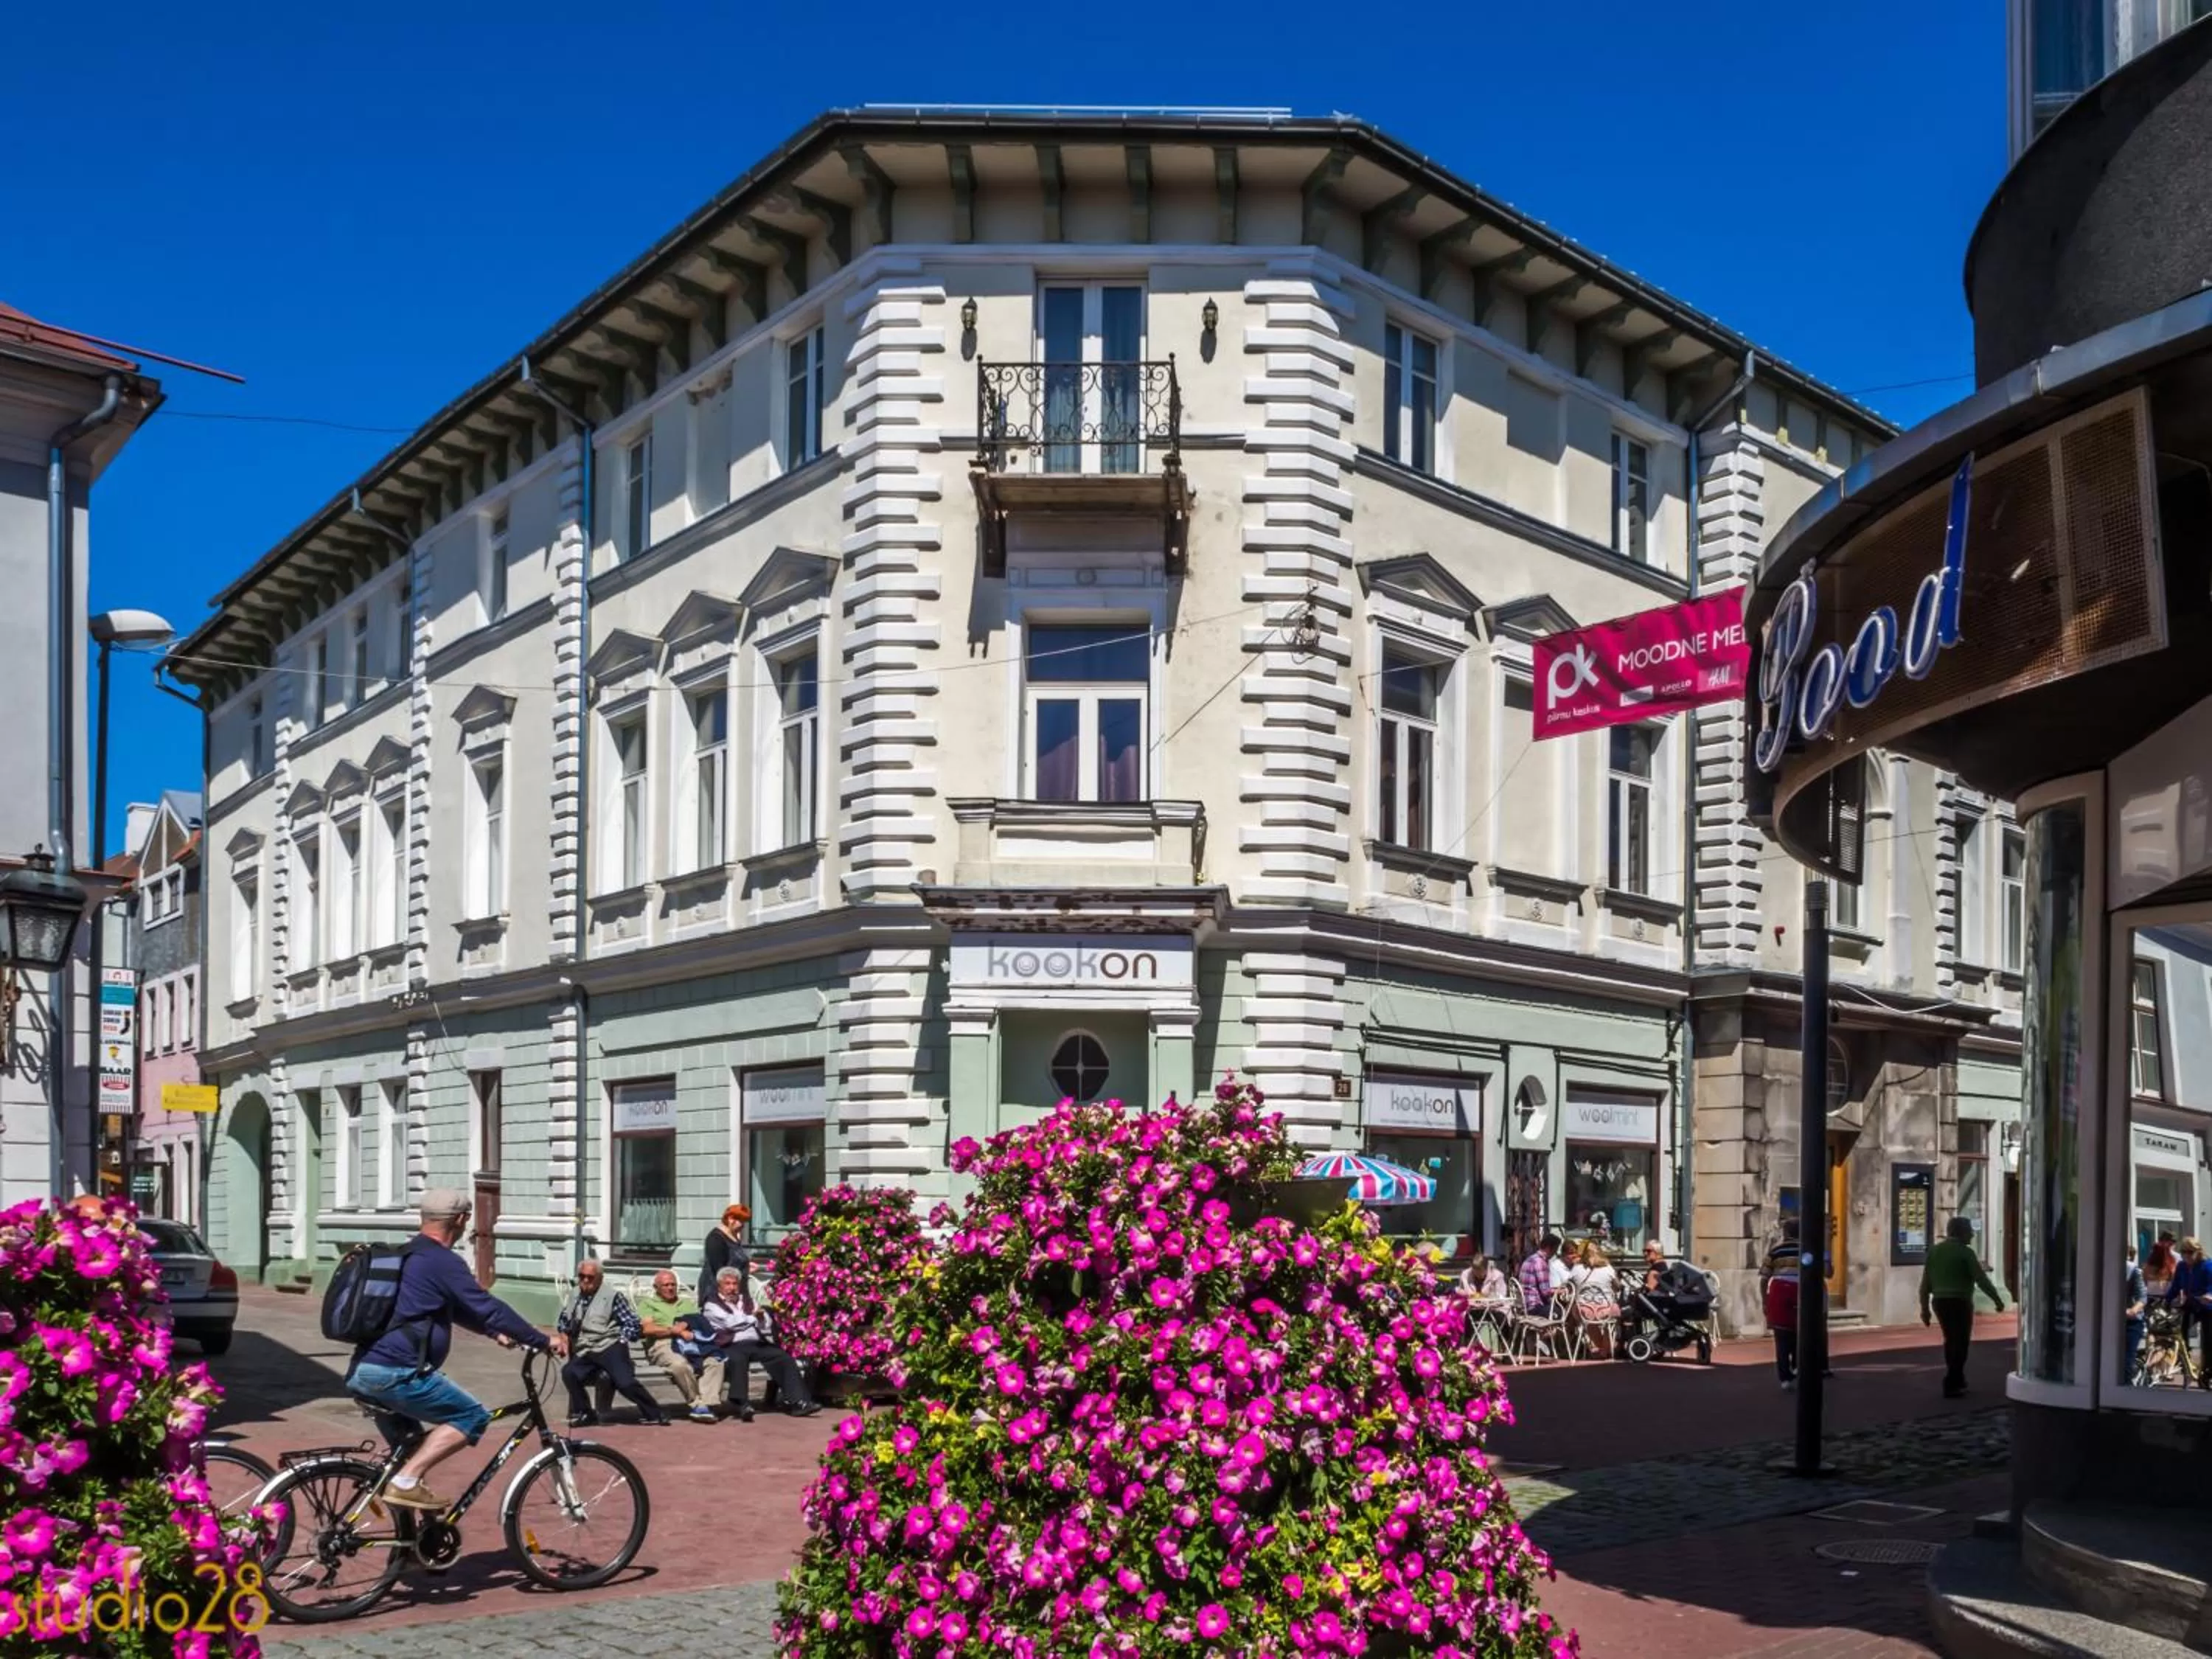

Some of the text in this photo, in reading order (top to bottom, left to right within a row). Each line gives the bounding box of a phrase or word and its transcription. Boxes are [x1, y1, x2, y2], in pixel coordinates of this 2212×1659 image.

[1618, 623, 1745, 673] MOODNE ME
[1660, 679, 1692, 693] APOLLO
[988, 940, 1156, 979] kookon
[1391, 1088, 1454, 1114] kookon
